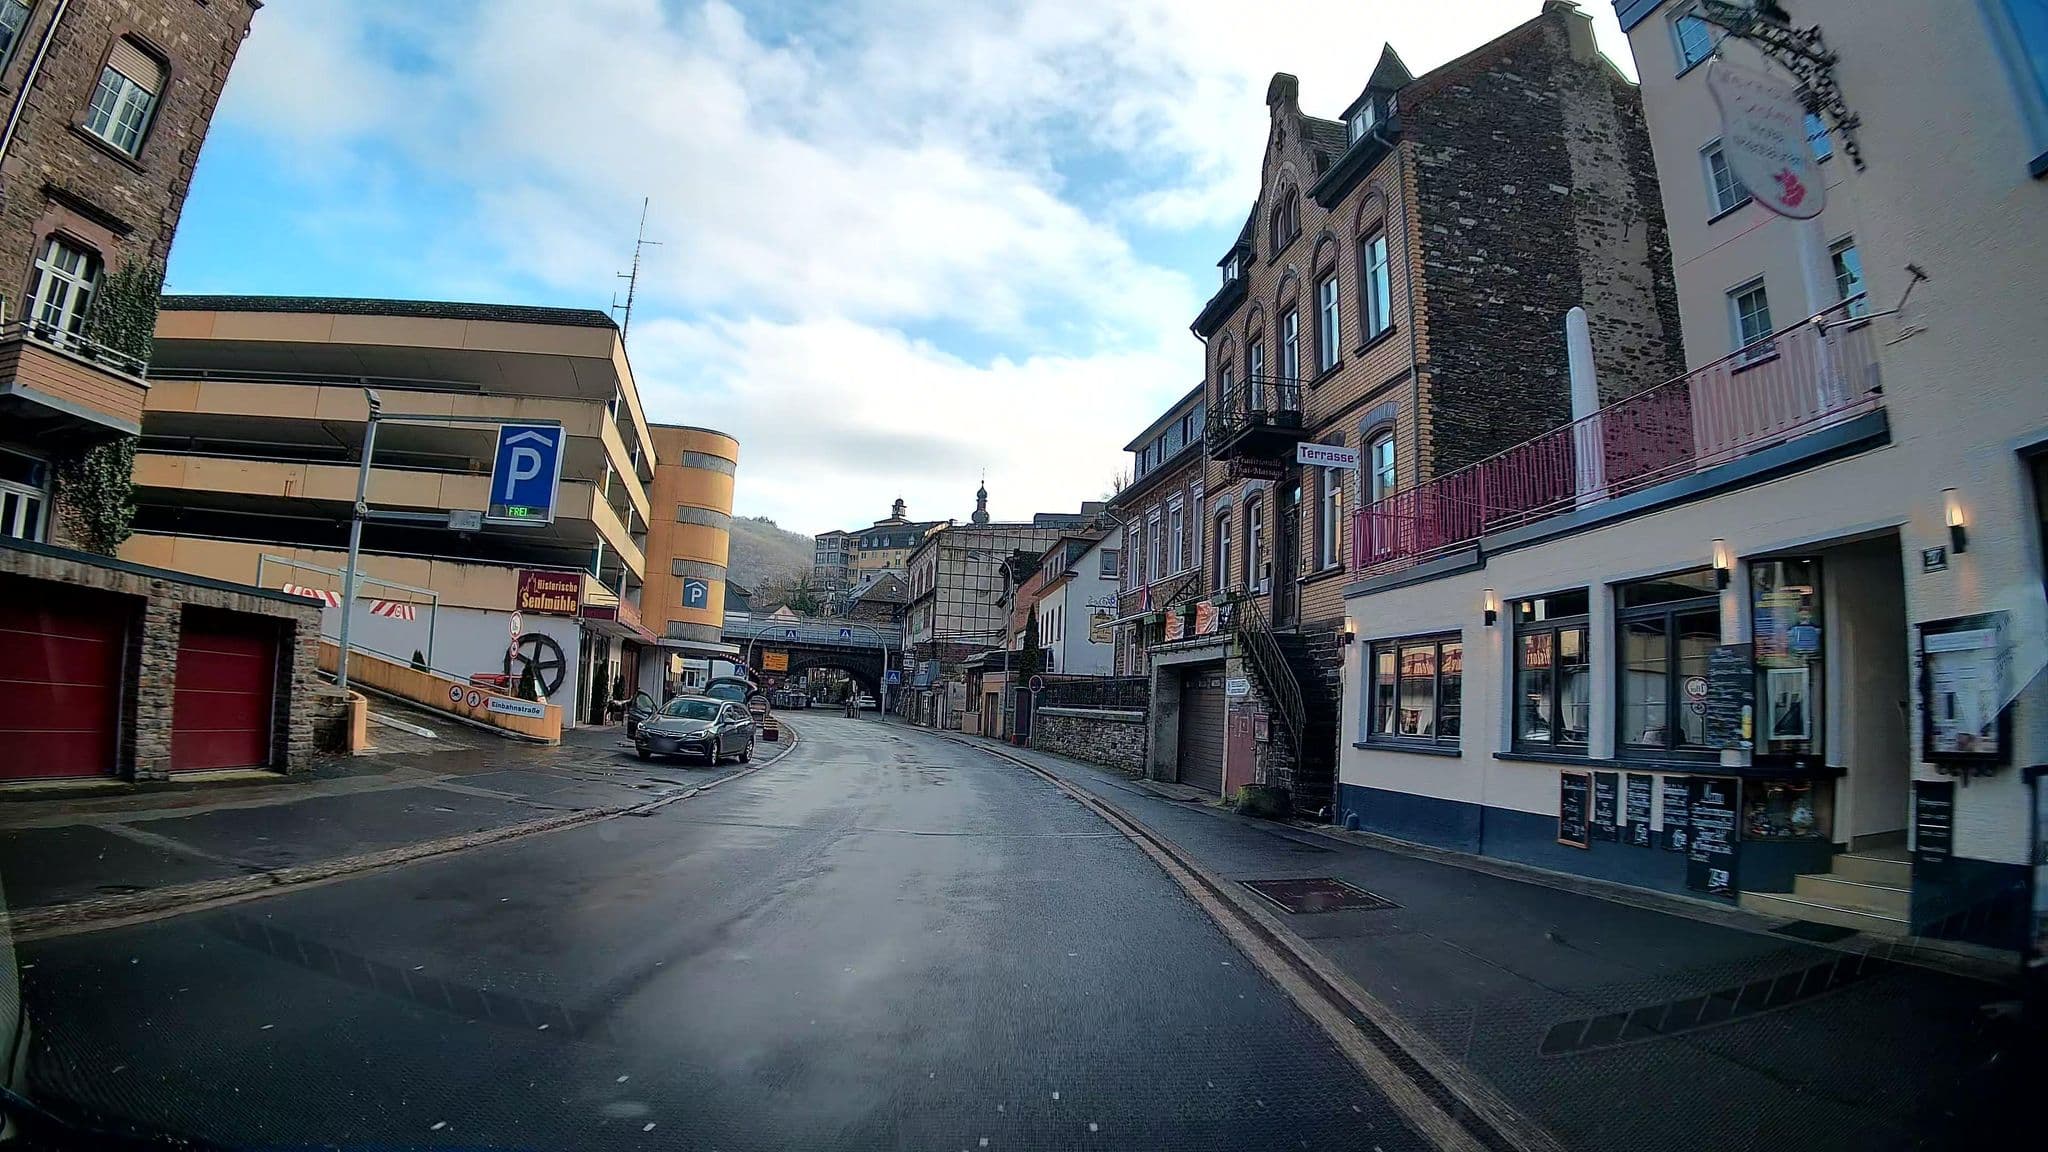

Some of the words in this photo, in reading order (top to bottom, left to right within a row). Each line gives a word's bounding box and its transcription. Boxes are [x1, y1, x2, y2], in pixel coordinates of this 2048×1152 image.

[1300, 446, 1354, 463] Terrasse
[505, 447, 542, 500] P
[508, 506, 528, 517] FREI
[537, 579, 578, 593] Historische
[521, 592, 577, 612] Senfmühle
[691, 587, 702, 603] P
[491, 701, 540, 715] Einbahnstraße
